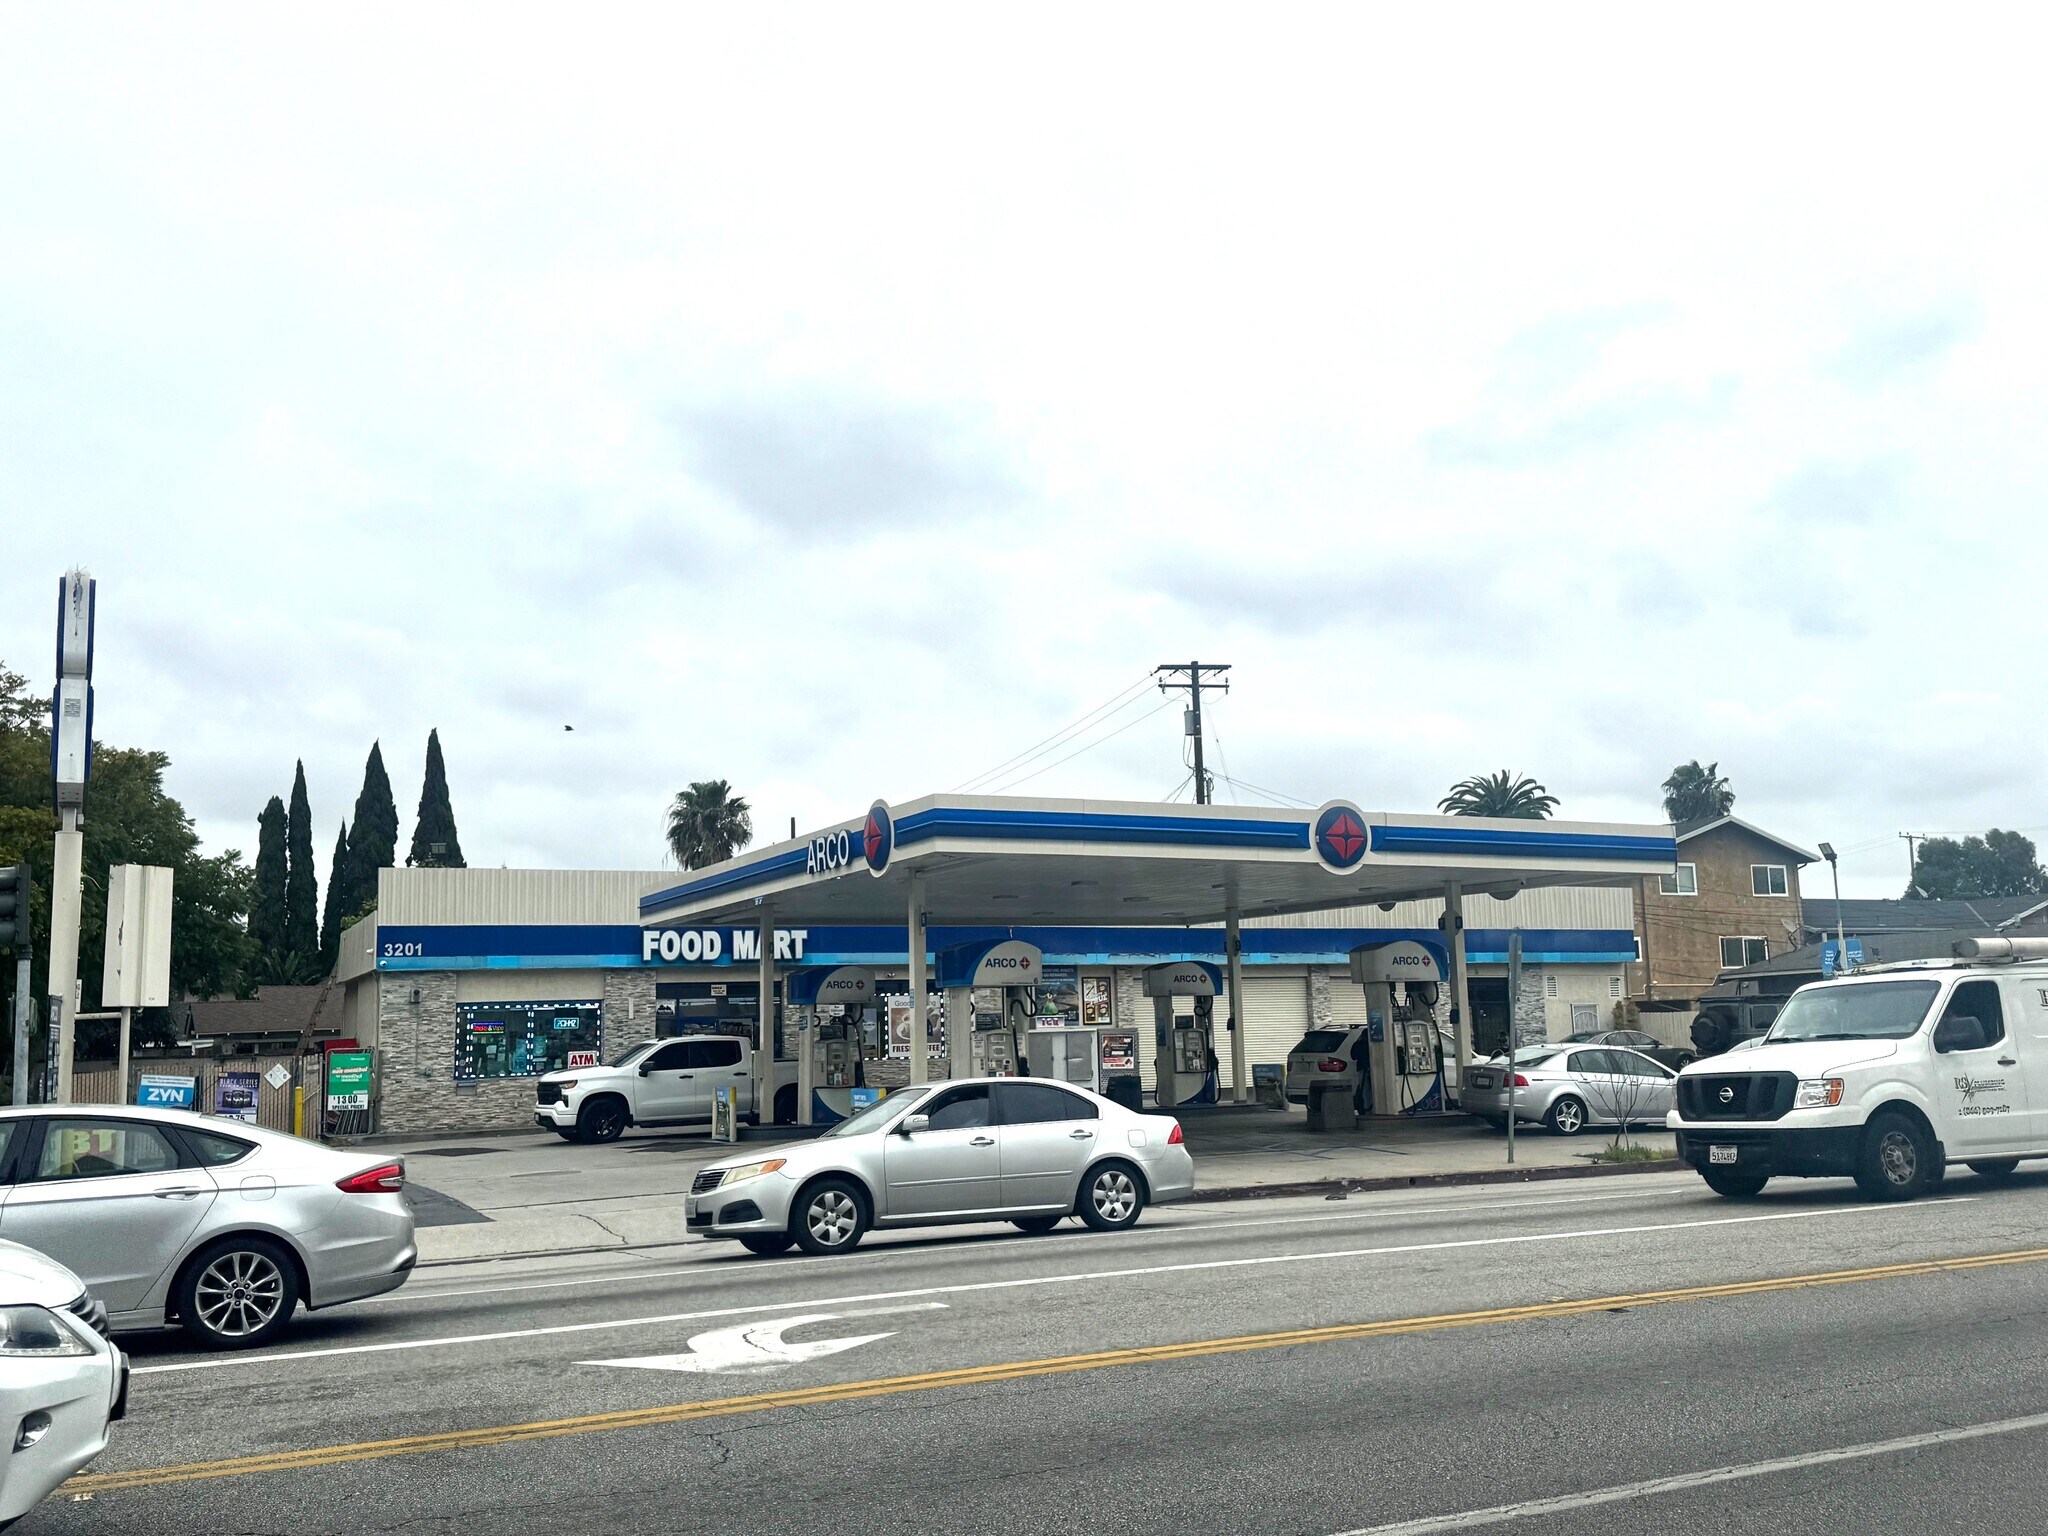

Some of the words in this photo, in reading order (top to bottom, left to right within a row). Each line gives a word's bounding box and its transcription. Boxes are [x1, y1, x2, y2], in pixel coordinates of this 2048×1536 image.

[807, 829, 849, 874] ARCO
[384, 943, 422, 957] 3201
[643, 930, 722, 961] FOOD
[985, 958, 1017, 968] ARCO
[1392, 956, 1420, 965] ARCO
[826, 980, 853, 989] ARCO
[1173, 975, 1198, 983] ARCO
[570, 1054, 594, 1066] ATM
[219, 1078, 238, 1086] BLACK
[239, 1078, 258, 1086] SERIES
[147, 1088, 185, 1103] ZYN
